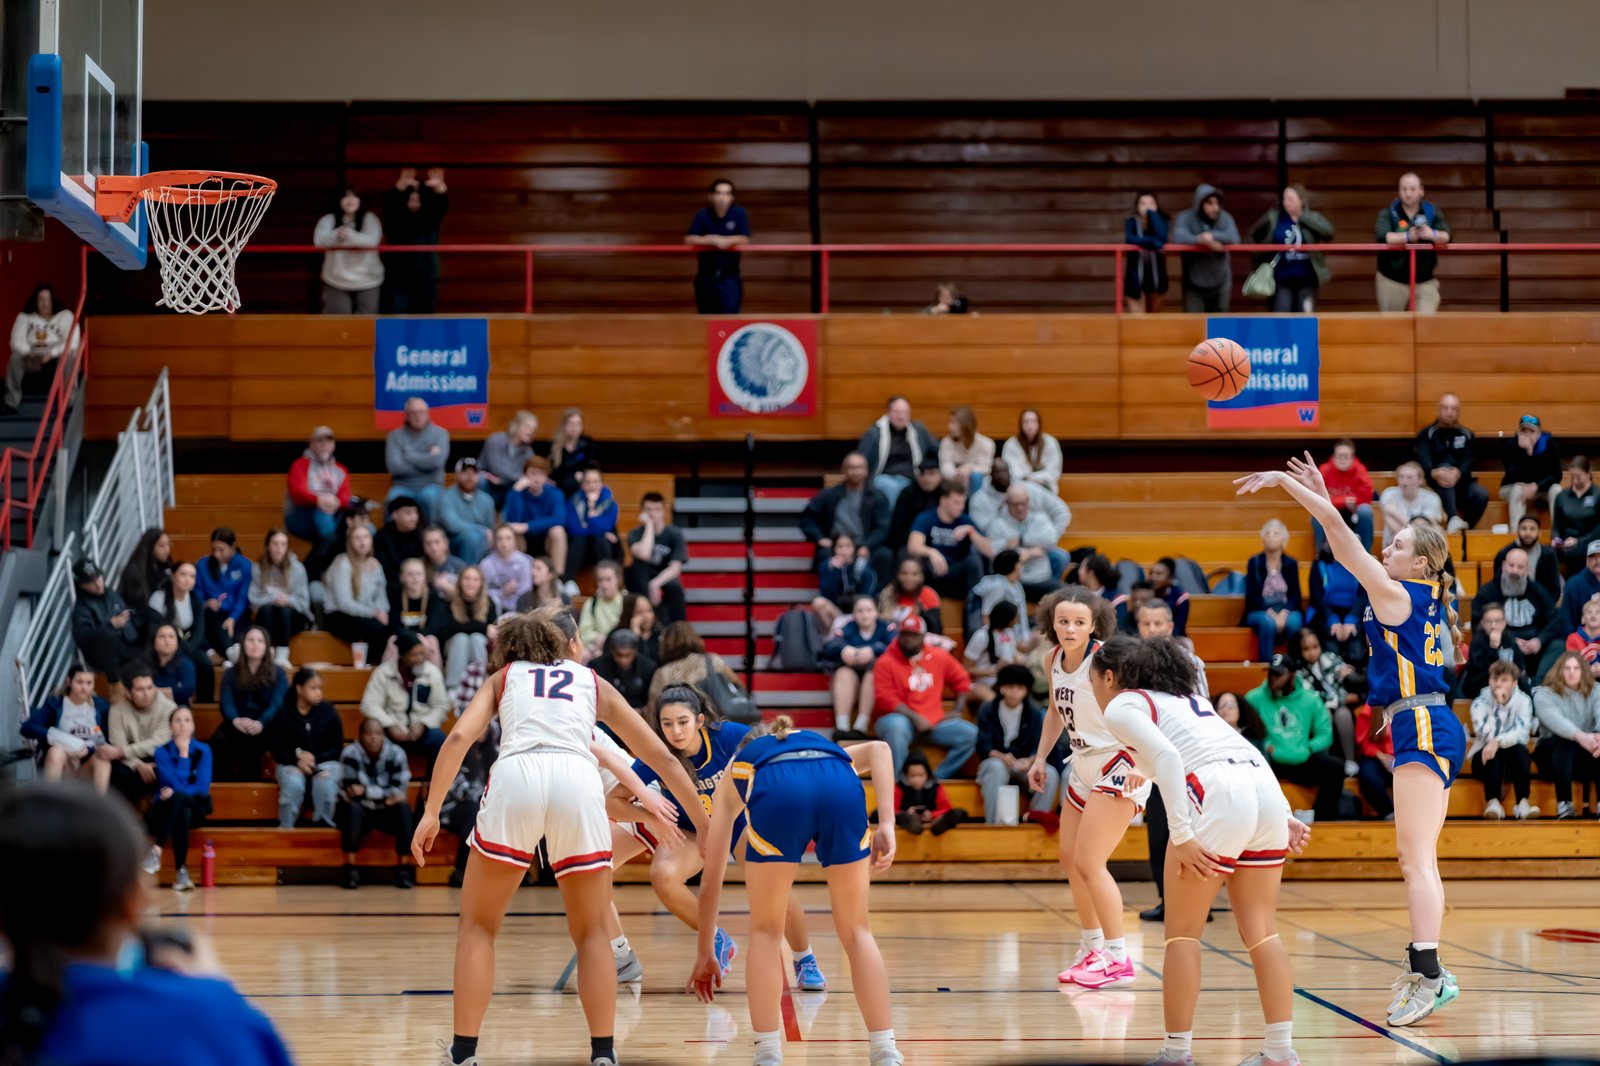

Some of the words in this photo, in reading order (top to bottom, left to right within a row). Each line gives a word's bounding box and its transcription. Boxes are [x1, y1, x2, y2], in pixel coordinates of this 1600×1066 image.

[396, 345, 467, 367] General
[1245, 343, 1298, 366] eneral
[385, 370, 478, 393] Admission
[1246, 369, 1309, 391] mission
[1298, 407, 1315, 423] W
[527, 668, 574, 702] 12
[1055, 687, 1075, 705] WEST
